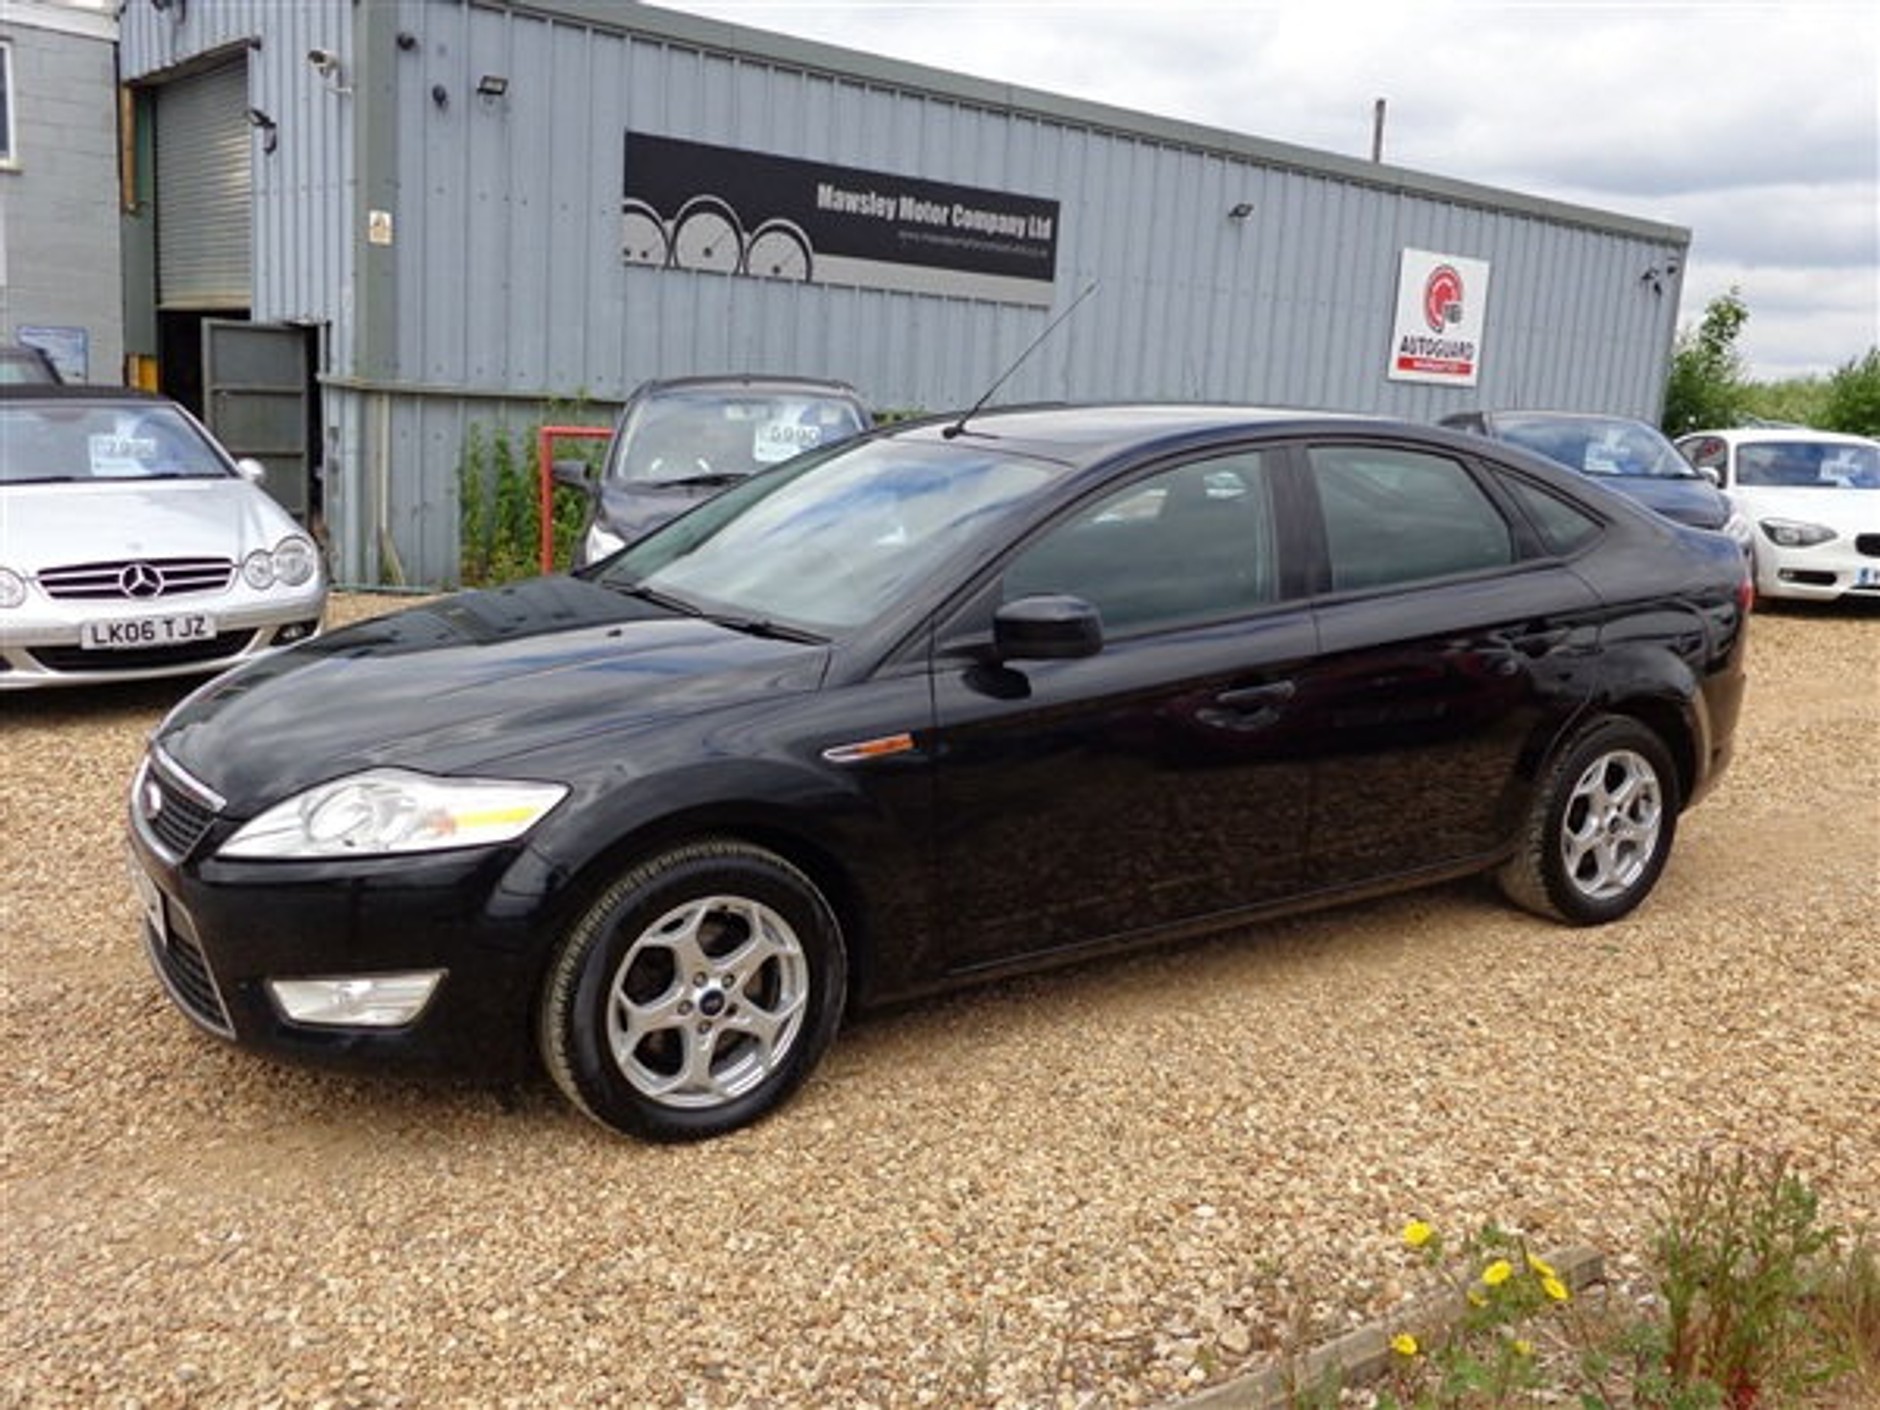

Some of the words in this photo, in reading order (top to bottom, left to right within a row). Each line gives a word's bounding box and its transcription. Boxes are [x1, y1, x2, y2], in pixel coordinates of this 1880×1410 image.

[817, 183, 897, 221] Mawsley
[899, 197, 950, 226] Motor
[952, 204, 1028, 239] Company
[1028, 214, 1053, 240] Ltd
[1400, 335, 1475, 361] AUTOGUARD
[91, 620, 155, 644] LK06
[162, 616, 206, 638] TJZ
